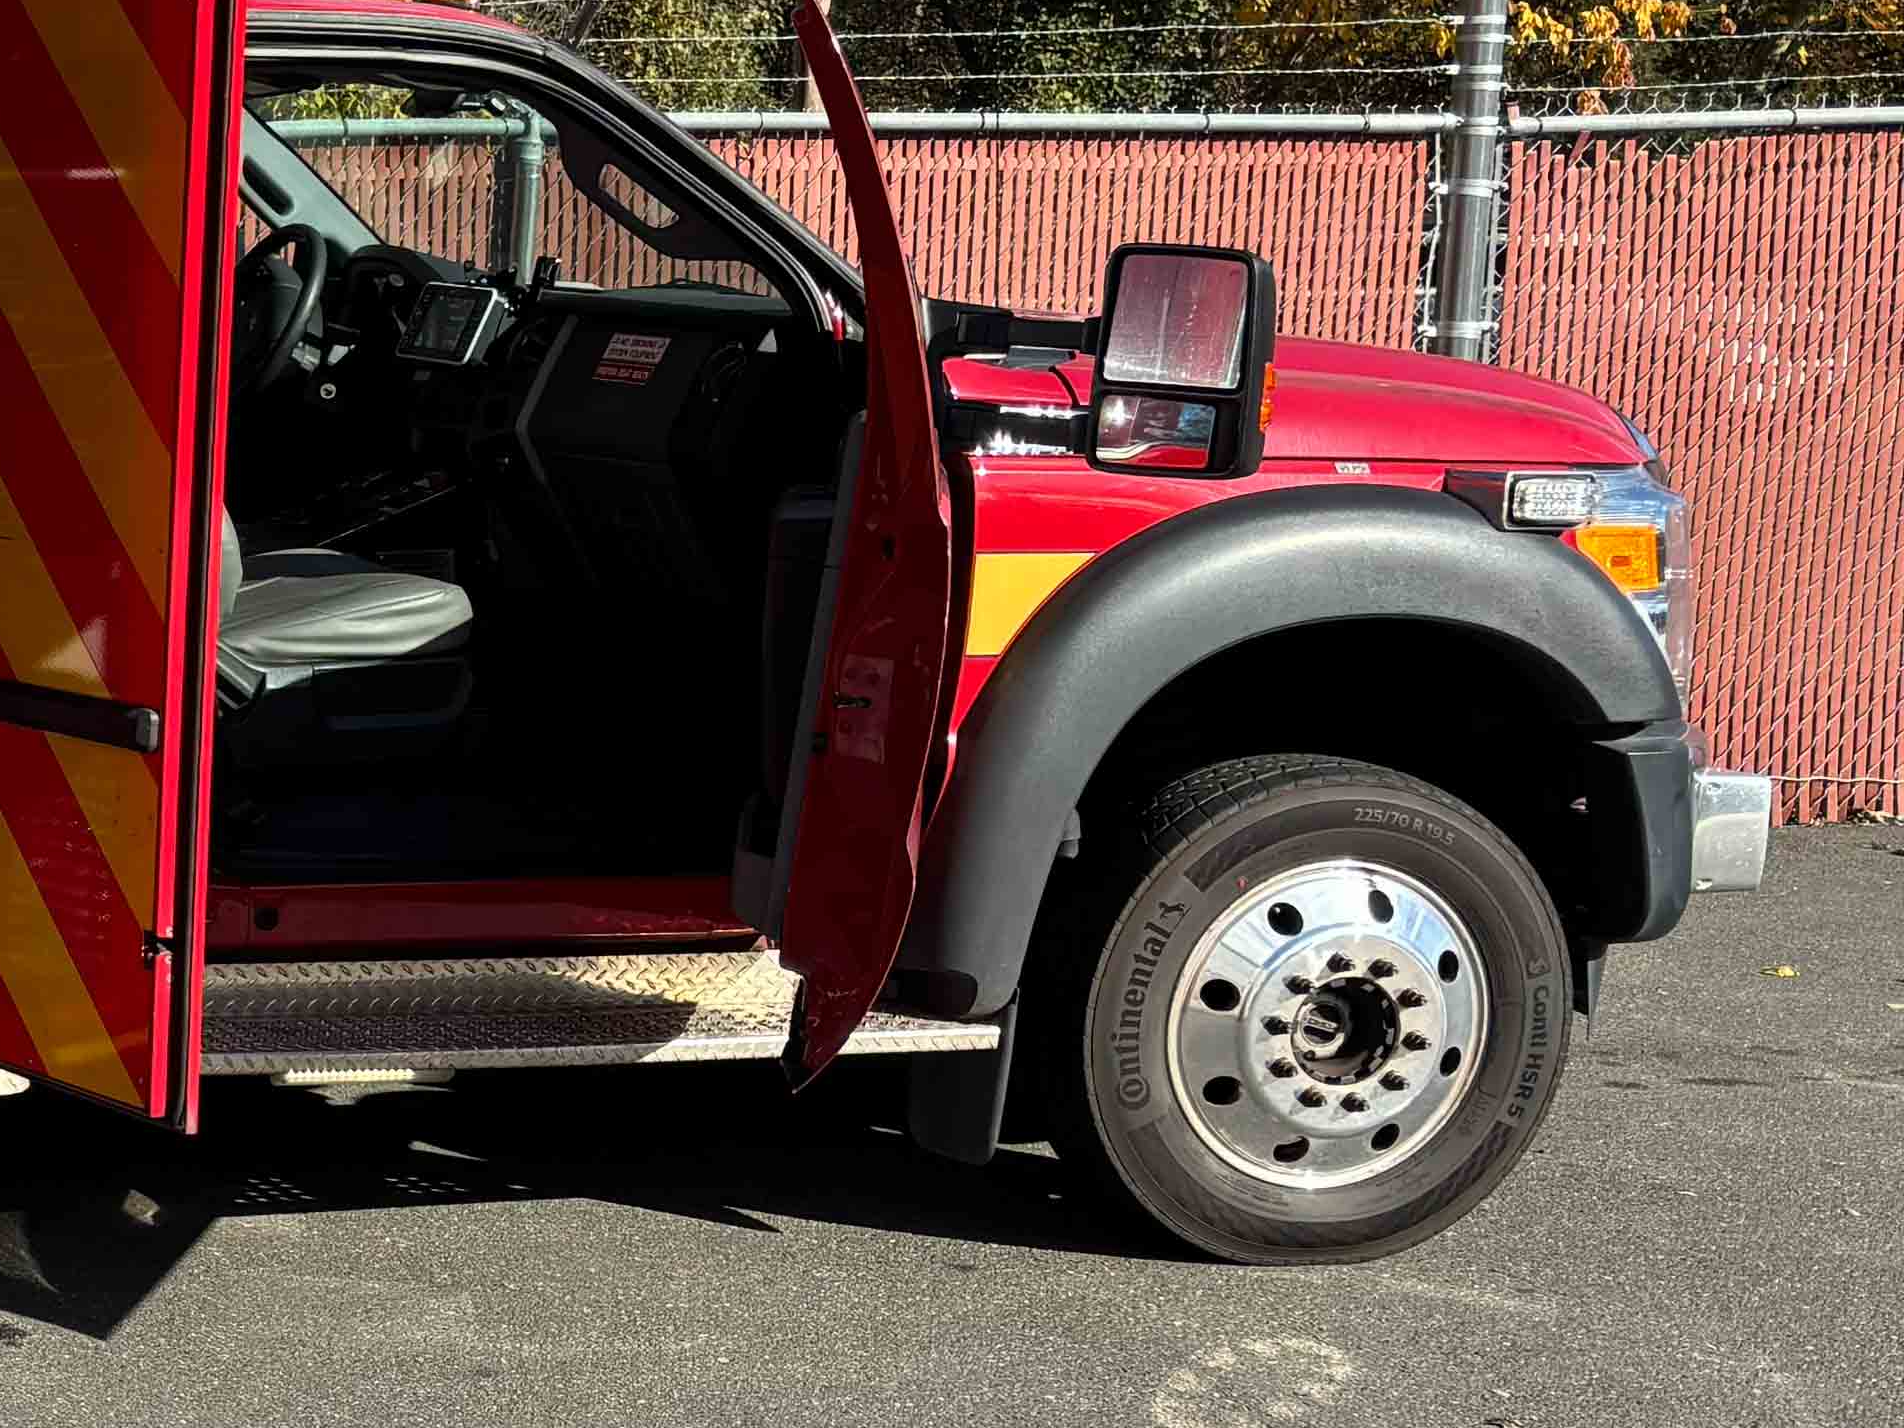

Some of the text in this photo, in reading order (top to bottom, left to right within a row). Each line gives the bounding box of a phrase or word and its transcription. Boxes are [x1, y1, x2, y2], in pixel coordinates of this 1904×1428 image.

[1353, 807, 1456, 845] 225/70 R 19.5
[1110, 922, 1173, 1111] Continental
[1507, 984, 1550, 1119] Conti HSR 5
